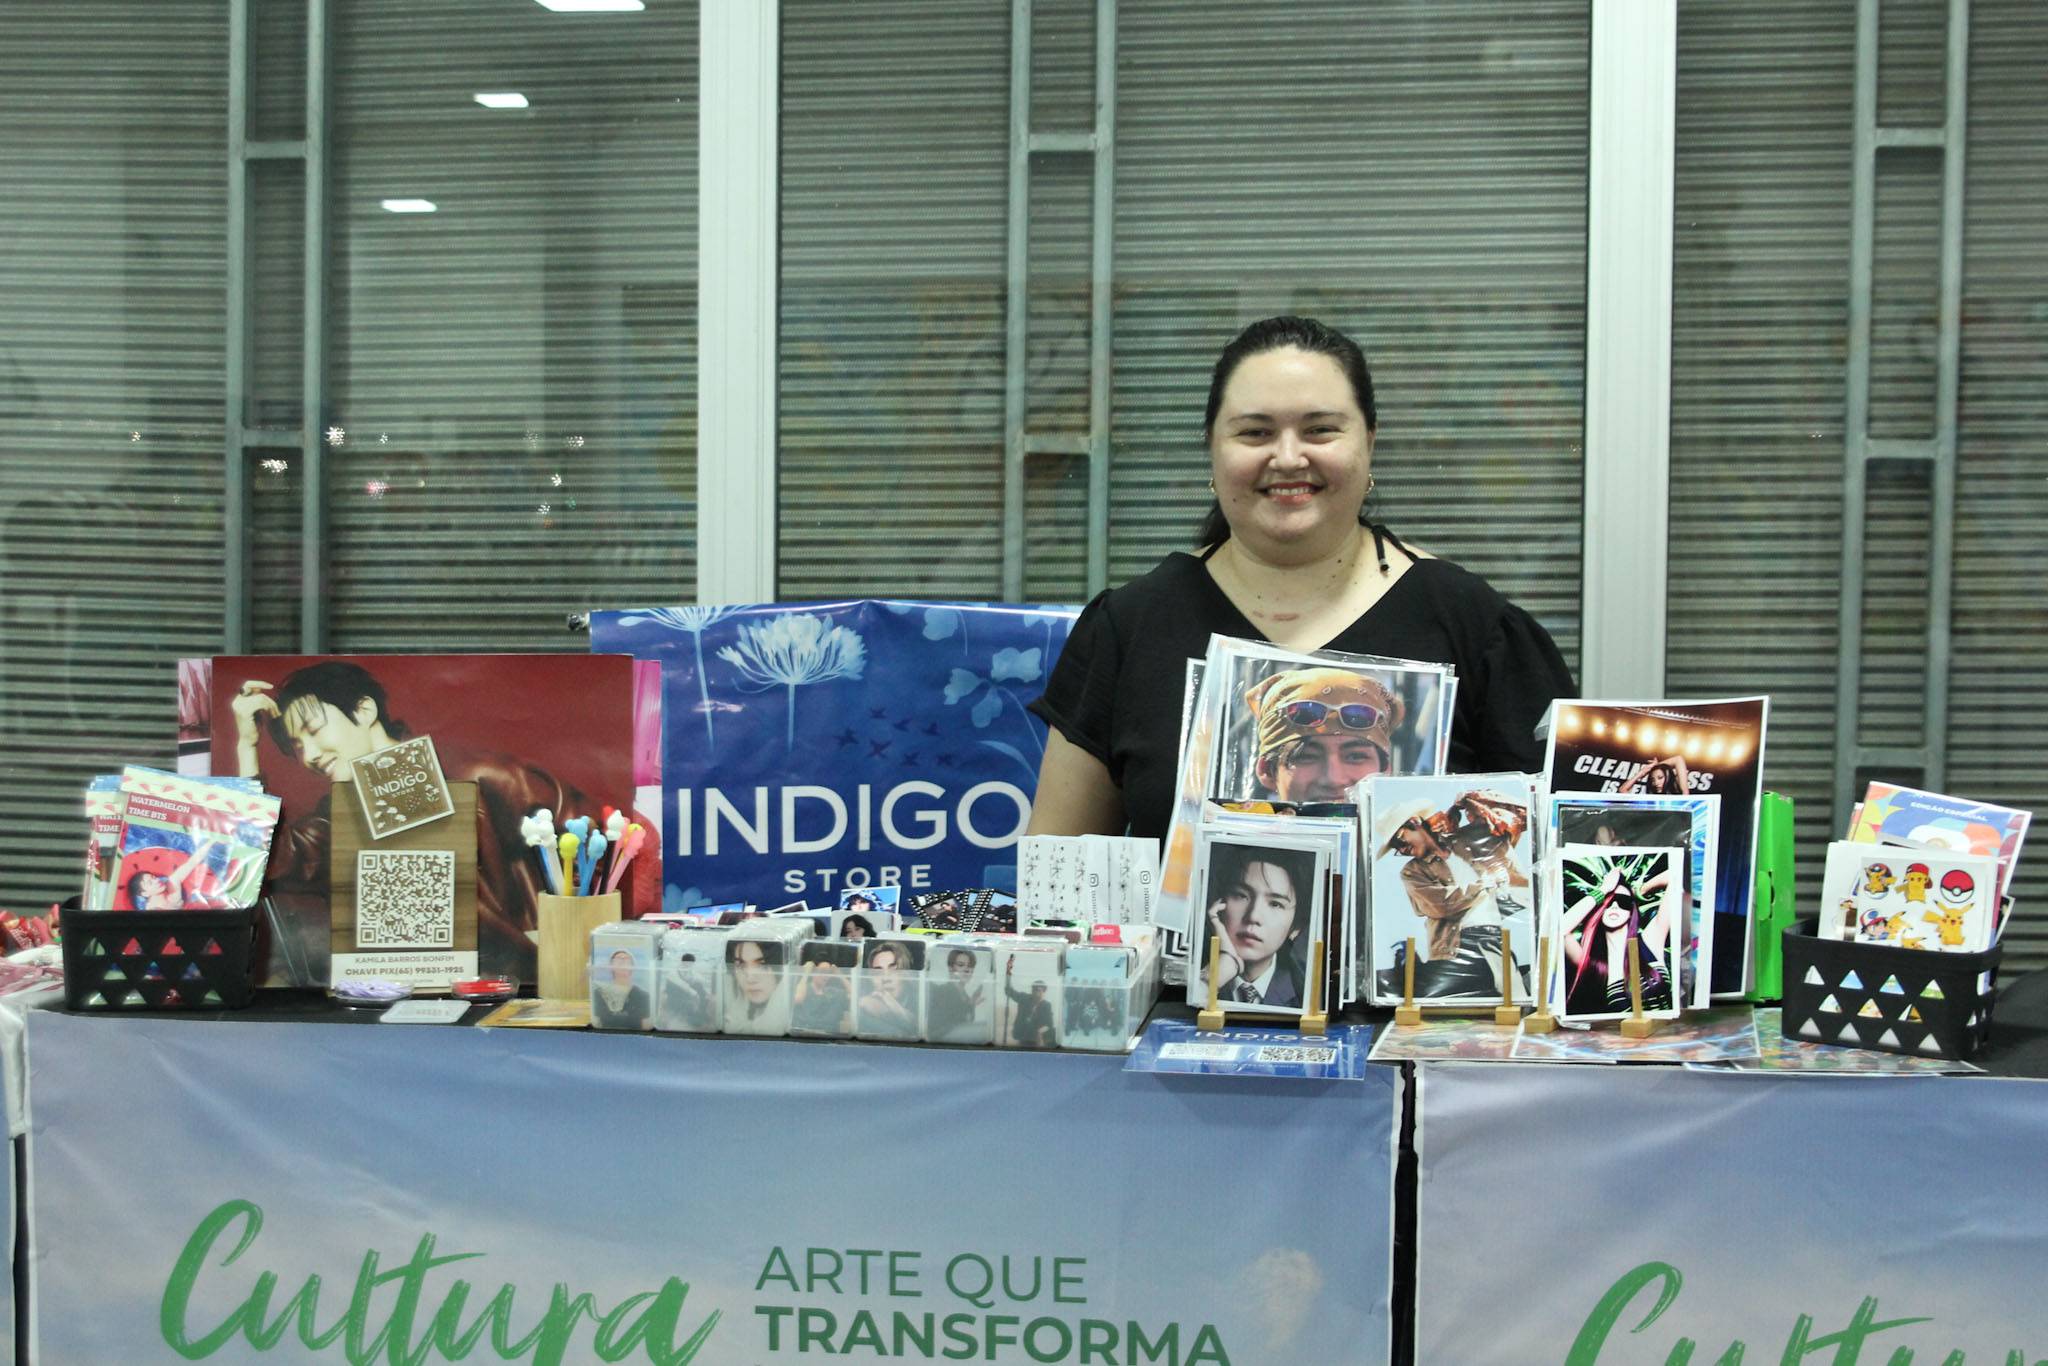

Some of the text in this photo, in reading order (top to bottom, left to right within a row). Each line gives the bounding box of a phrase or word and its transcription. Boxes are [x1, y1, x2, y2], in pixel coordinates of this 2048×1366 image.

[373, 771, 428, 797] INDIGO
[128, 807, 168, 821] TIME BTS
[130, 795, 191, 813] WATERMELON
[678, 780, 1033, 856] INDIGO
[783, 864, 932, 893] STORE
[345, 968, 377, 976] CHAVE
[355, 956, 386, 964] KAMILA
[388, 955, 421, 963] BARROS
[1194, 1031, 1329, 1042] INDIGO
[161, 1198, 723, 1366] Cultura
[754, 1245, 1088, 1309] ARTE QUE
[754, 1304, 1232, 1366] TRANSFORMA
